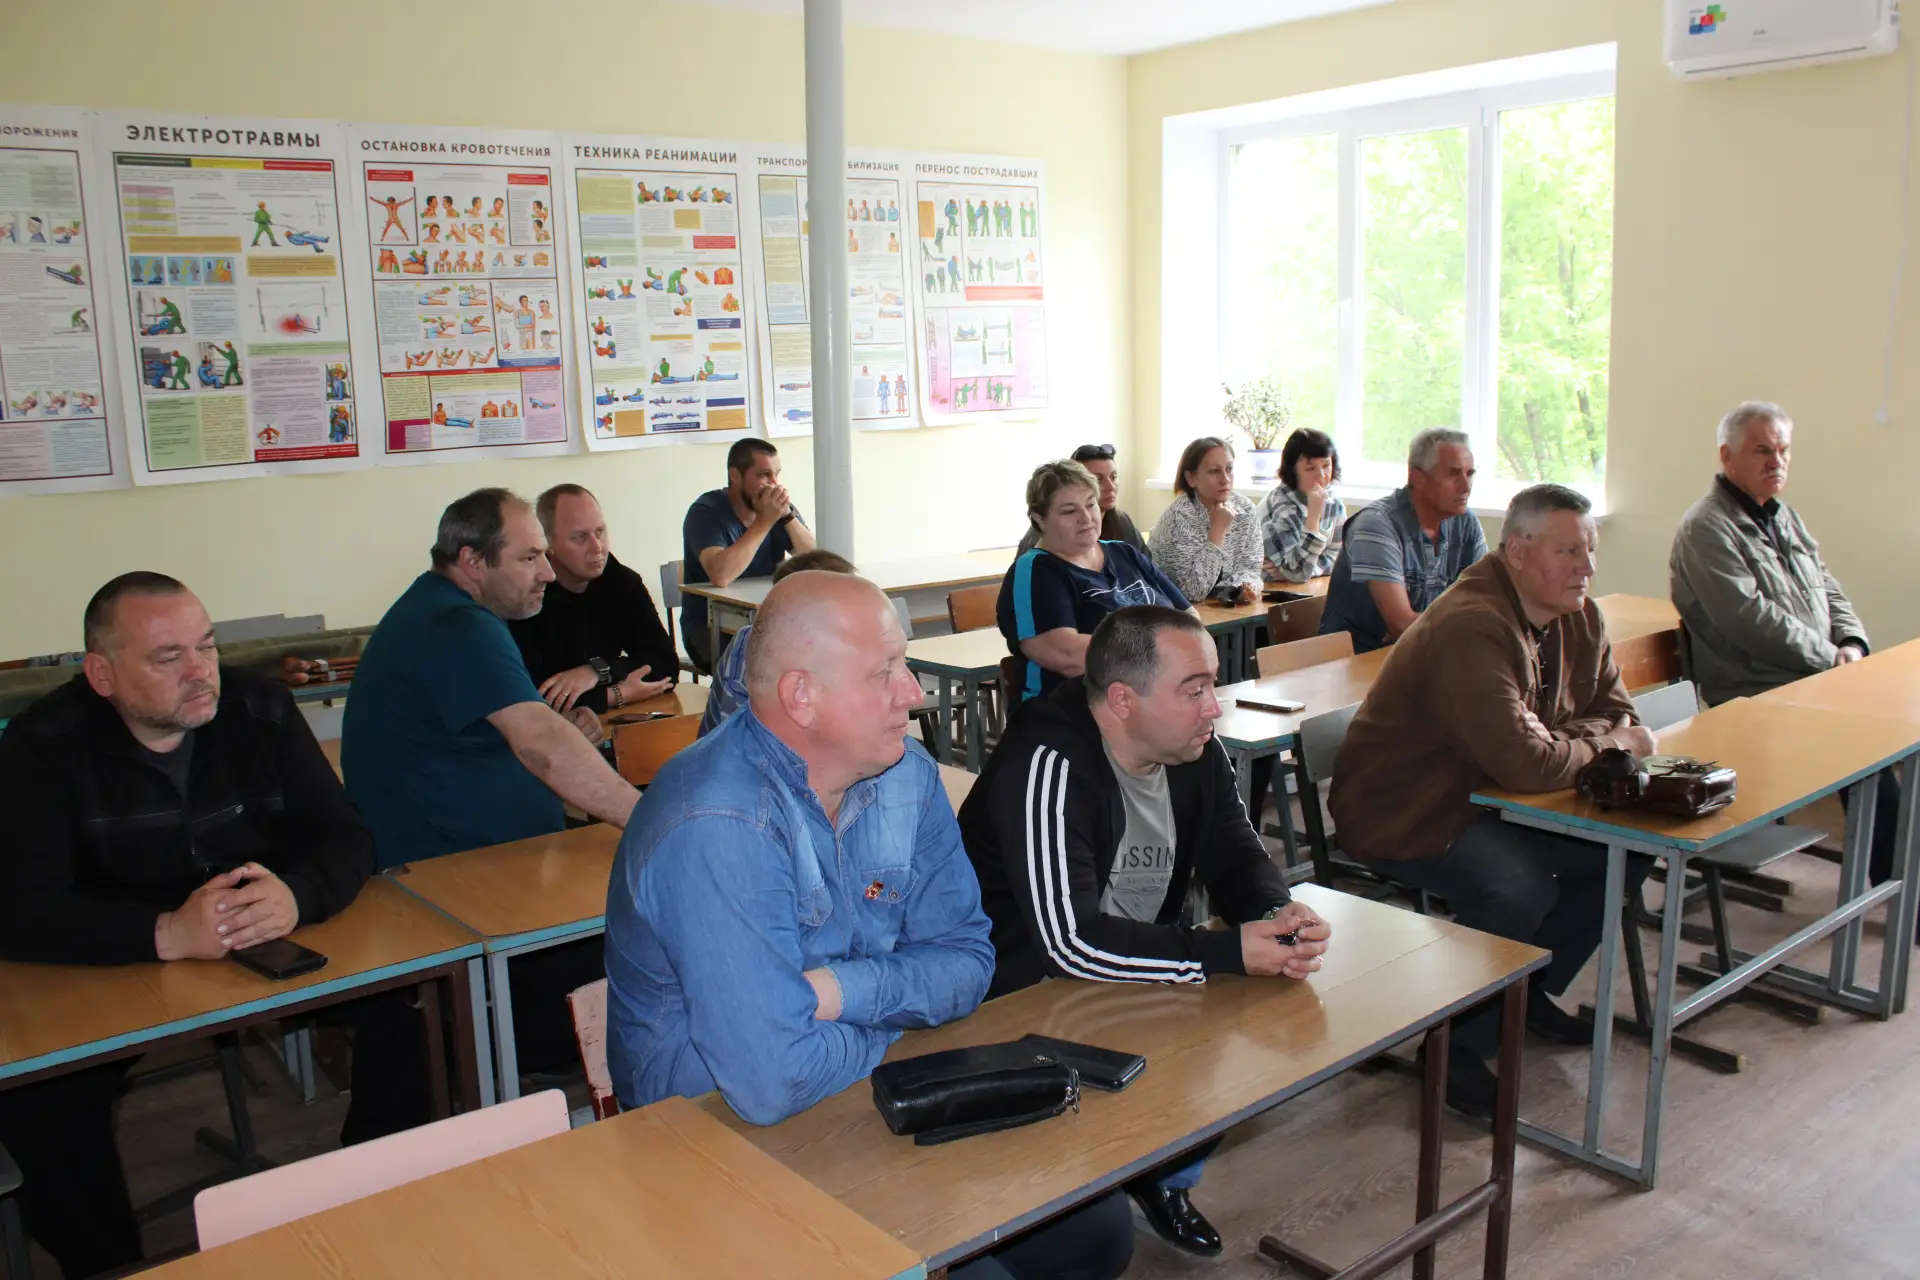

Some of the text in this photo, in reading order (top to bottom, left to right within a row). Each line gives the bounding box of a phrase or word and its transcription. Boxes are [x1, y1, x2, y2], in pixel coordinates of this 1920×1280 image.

[0, 125, 79, 138] ОРОЖЕНИЯ
[126, 124, 321, 148] ЭЛЕКТРОТРАВМЫ
[361, 140, 551, 157] ОСТАНОВКА КРОВОТЕЧЕНИЯ
[574, 146, 737, 163] ТЕХНИКА РЕАНИМАЦИИ
[915, 163, 1038, 178] ПЕРЕНОС ПОСТРАДАВШИХ
